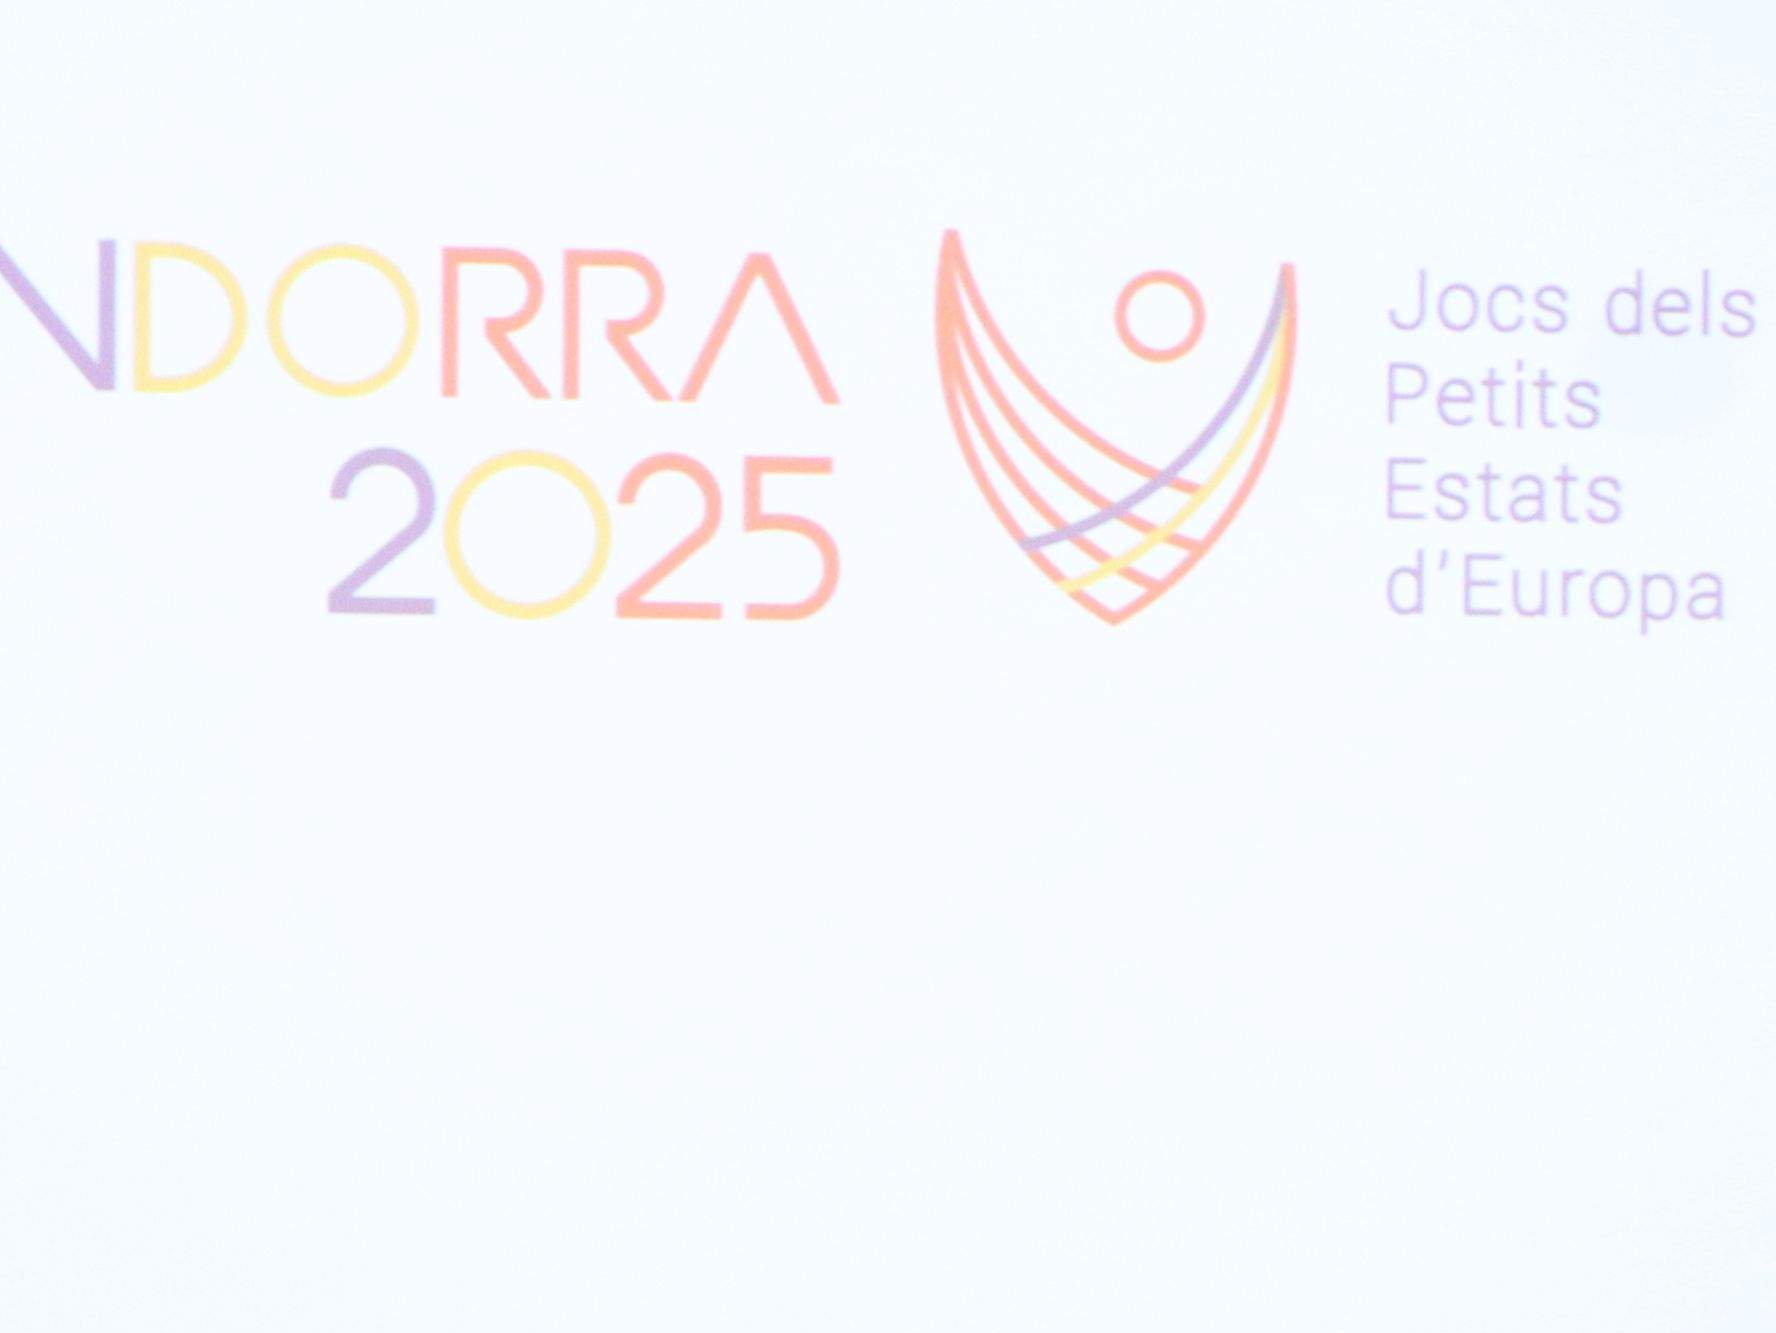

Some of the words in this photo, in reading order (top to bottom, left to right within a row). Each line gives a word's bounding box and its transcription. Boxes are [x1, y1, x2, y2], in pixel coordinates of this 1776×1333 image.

[1388, 267, 1569, 333] Jocs
[1604, 267, 1757, 338] dels
[1386, 358, 1602, 430] Petits
[1386, 456, 1623, 525] Estats
[325, 446, 841, 622] 2025
[1385, 547, 1726, 636] d'Europa
